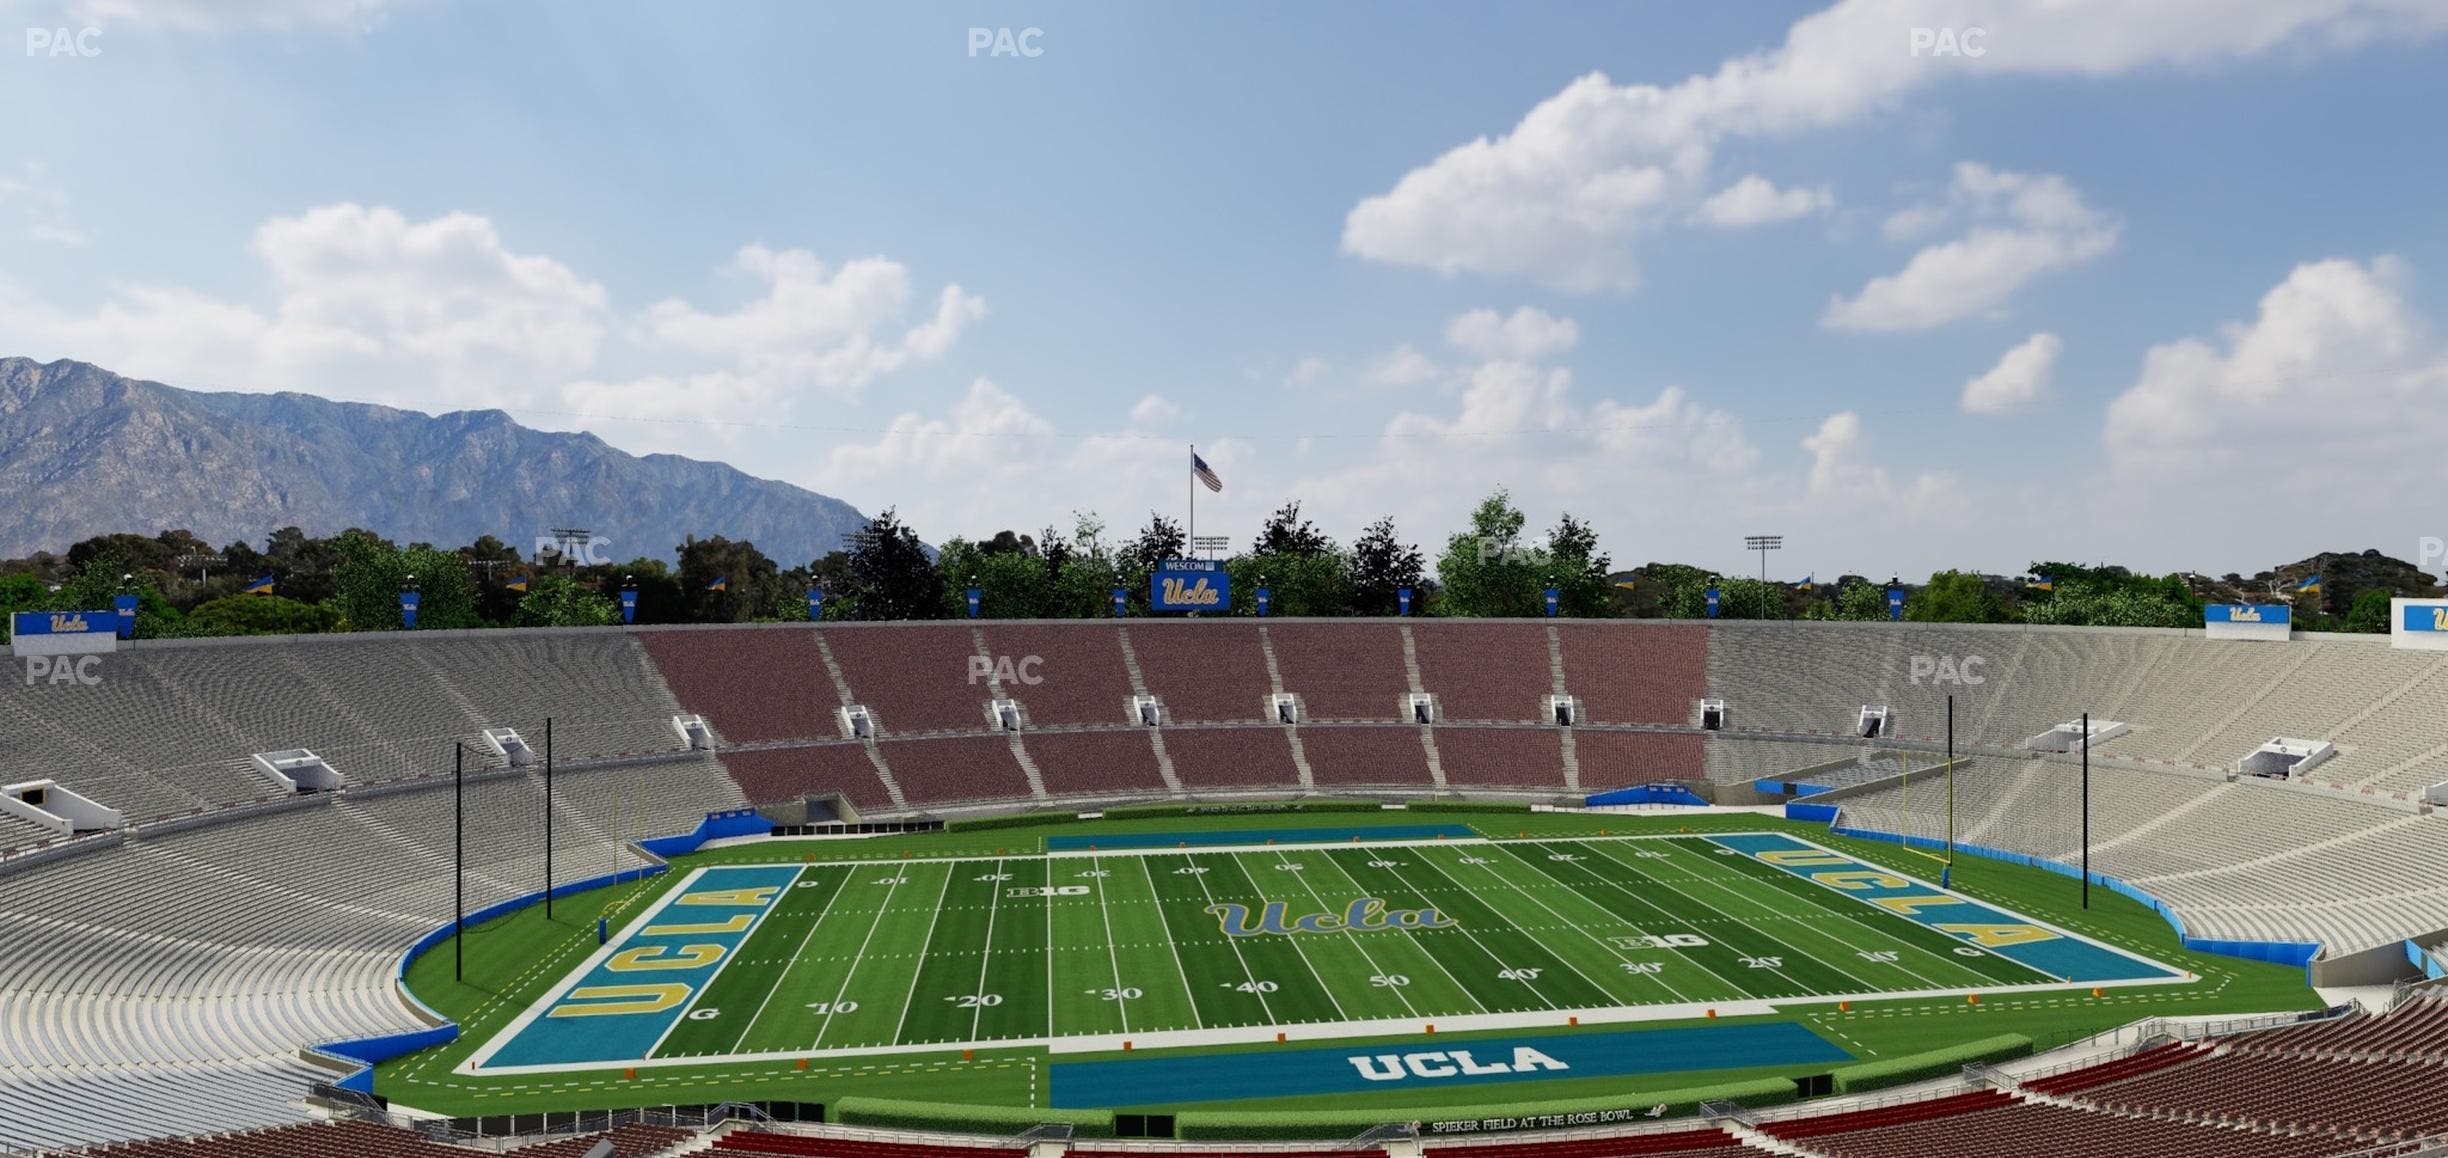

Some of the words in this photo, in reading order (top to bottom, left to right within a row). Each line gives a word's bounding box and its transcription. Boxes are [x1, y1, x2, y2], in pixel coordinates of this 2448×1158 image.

[1165, 562, 1205, 571] WESCOM
[1162, 577, 1220, 605] Ucla
[1755, 850, 2065, 948] UCLA
[1204, 897, 1459, 937] Ucla
[547, 886, 781, 1019] UCLA
[1856, 951, 1899, 962] 10
[1619, 962, 1663, 975] 30
[1738, 957, 1783, 968] 20
[1369, 974, 1410, 987] 50
[1497, 968, 1540, 980] 40
[1101, 987, 1143, 1000] 30
[1235, 981, 1279, 993] 40
[955, 994, 1003, 1008] 20
[688, 1008, 721, 1020] G
[812, 1001, 858, 1015] 10
[1347, 1047, 1570, 1081] UCLA
[1432, 1121, 1480, 1133] SPIEKER
[1483, 1118, 1517, 1131] FIELD
[1519, 1117, 1536, 1128] AT
[1538, 1115, 1564, 1127] THE
[1567, 1112, 1597, 1125] ROSE
[1600, 1109, 1634, 1122] BOWL
